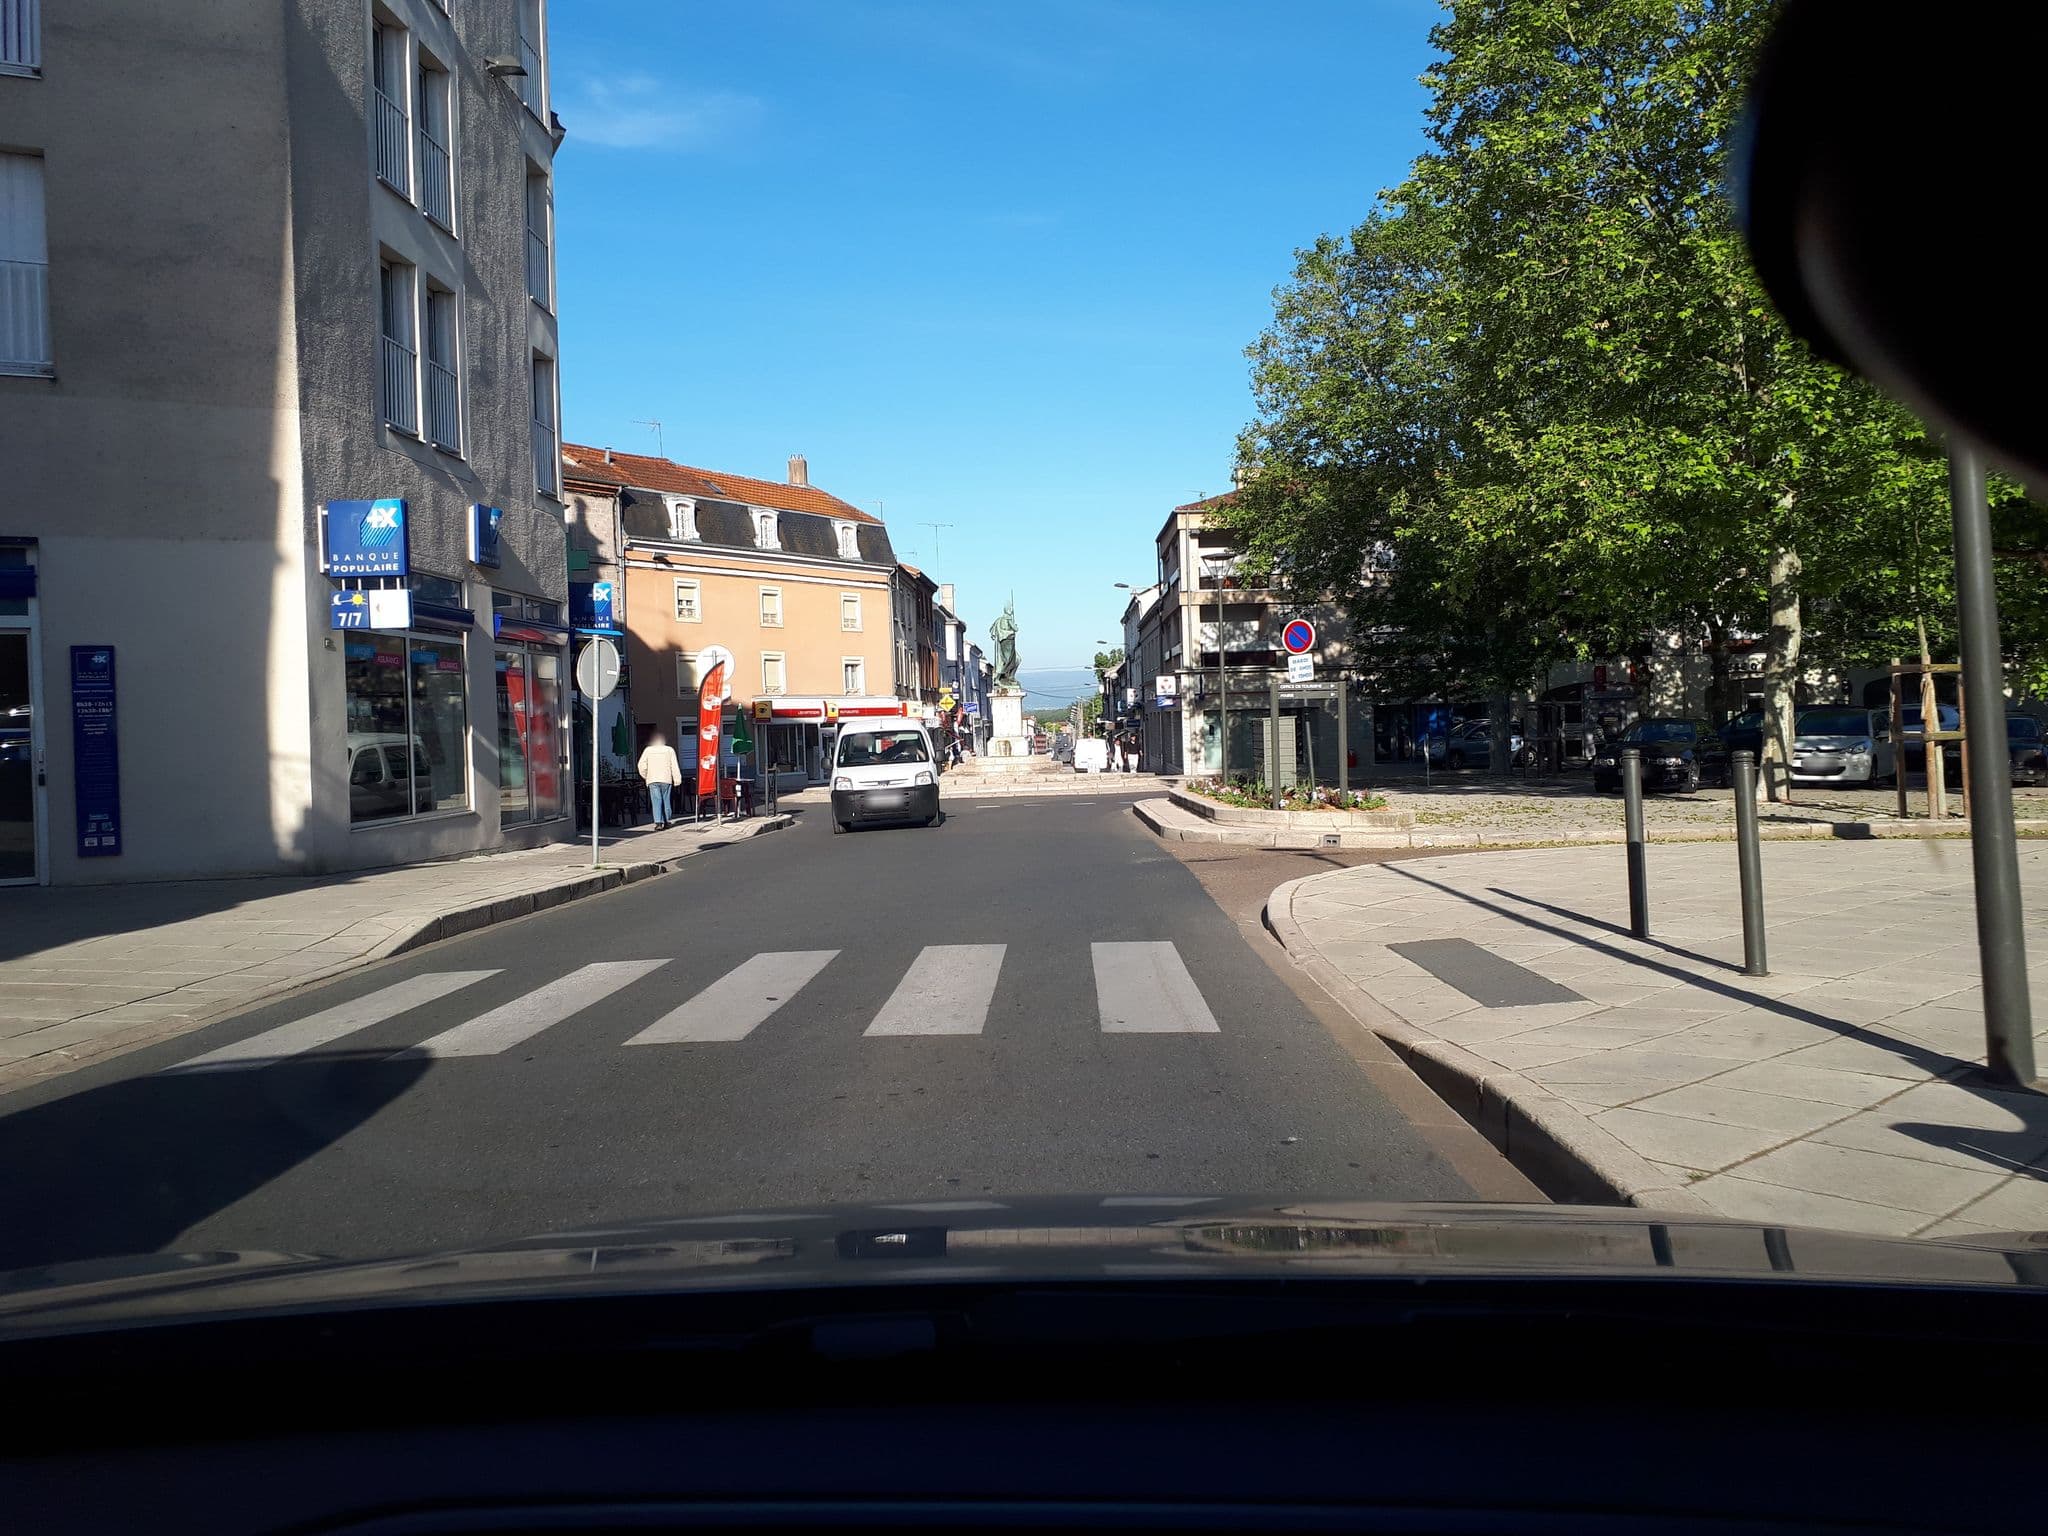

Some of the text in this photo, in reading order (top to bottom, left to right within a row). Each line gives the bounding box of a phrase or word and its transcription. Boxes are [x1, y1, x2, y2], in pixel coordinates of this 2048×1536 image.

[333, 552, 399, 562] BANQUE
[333, 563, 399, 573] POPULAIRE
[338, 612, 362, 627] 7/7
